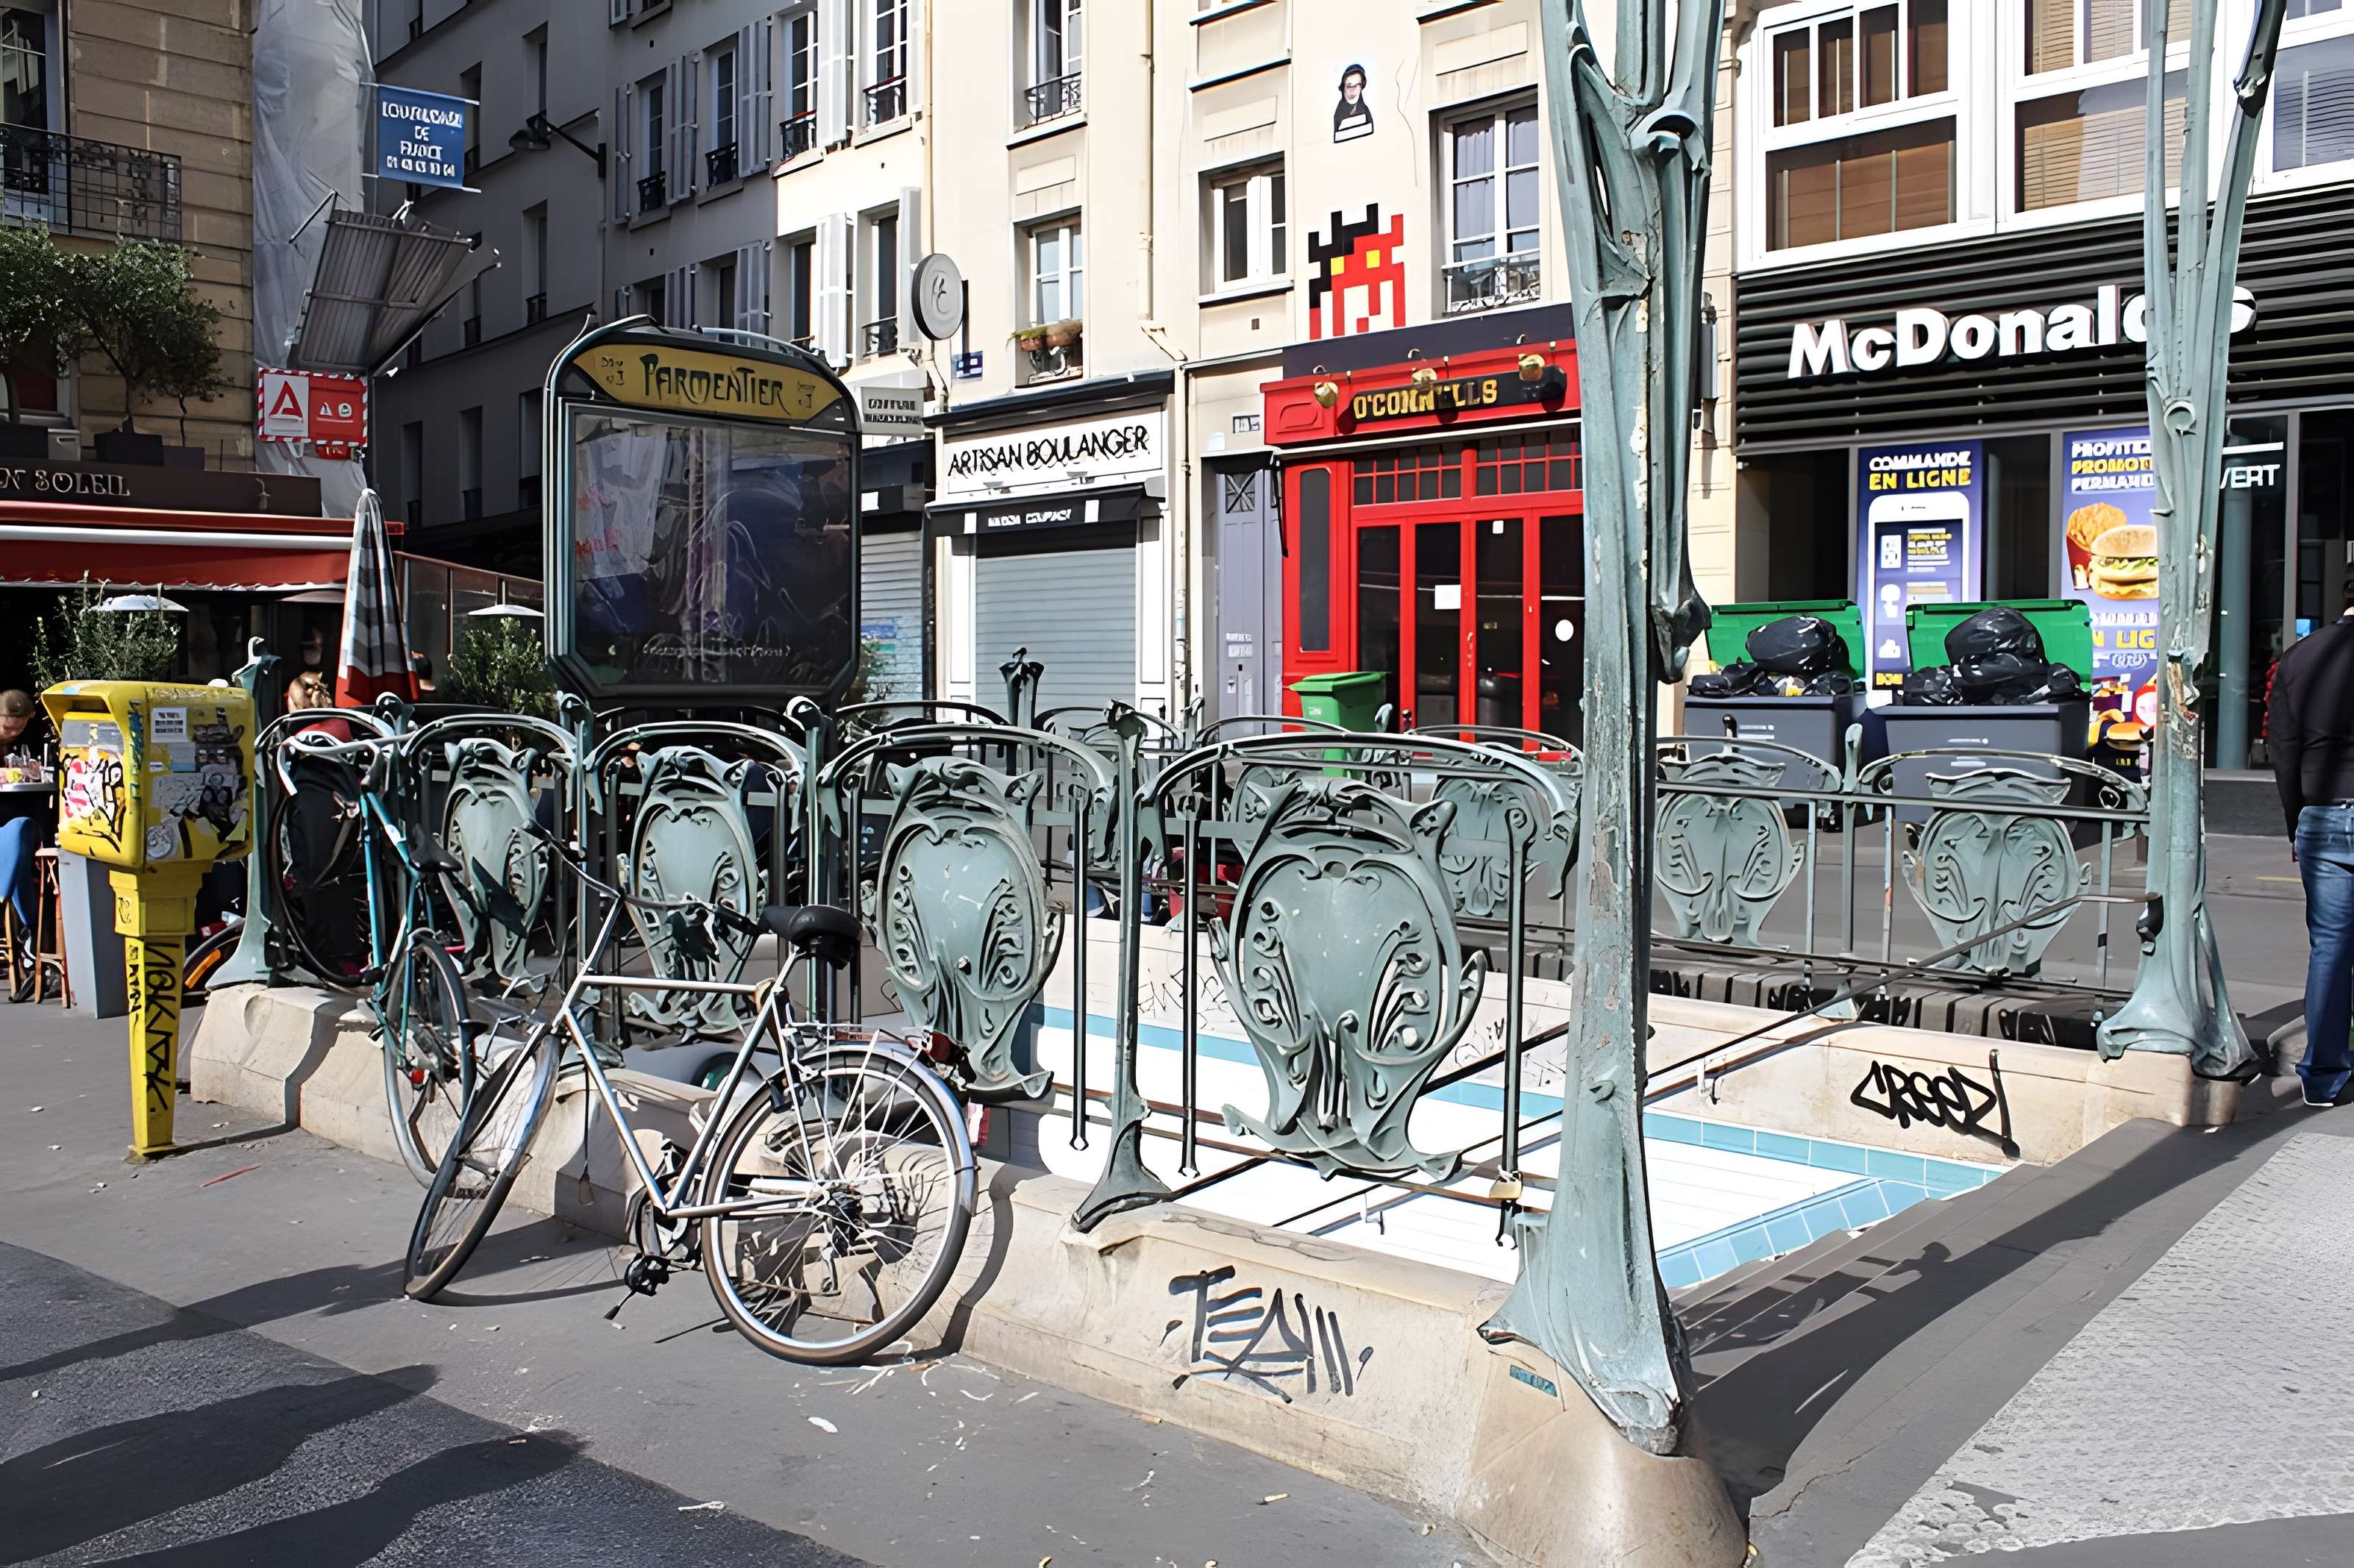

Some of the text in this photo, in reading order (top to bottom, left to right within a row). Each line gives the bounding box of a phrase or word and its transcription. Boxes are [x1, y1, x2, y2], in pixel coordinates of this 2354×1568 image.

[1788, 282, 2257, 379] McDonals
[947, 425, 1151, 477] ARTISAN BOULANGER
[1869, 451, 1971, 471] COMMANDE
[1869, 468, 1971, 491] EN LIGNE
